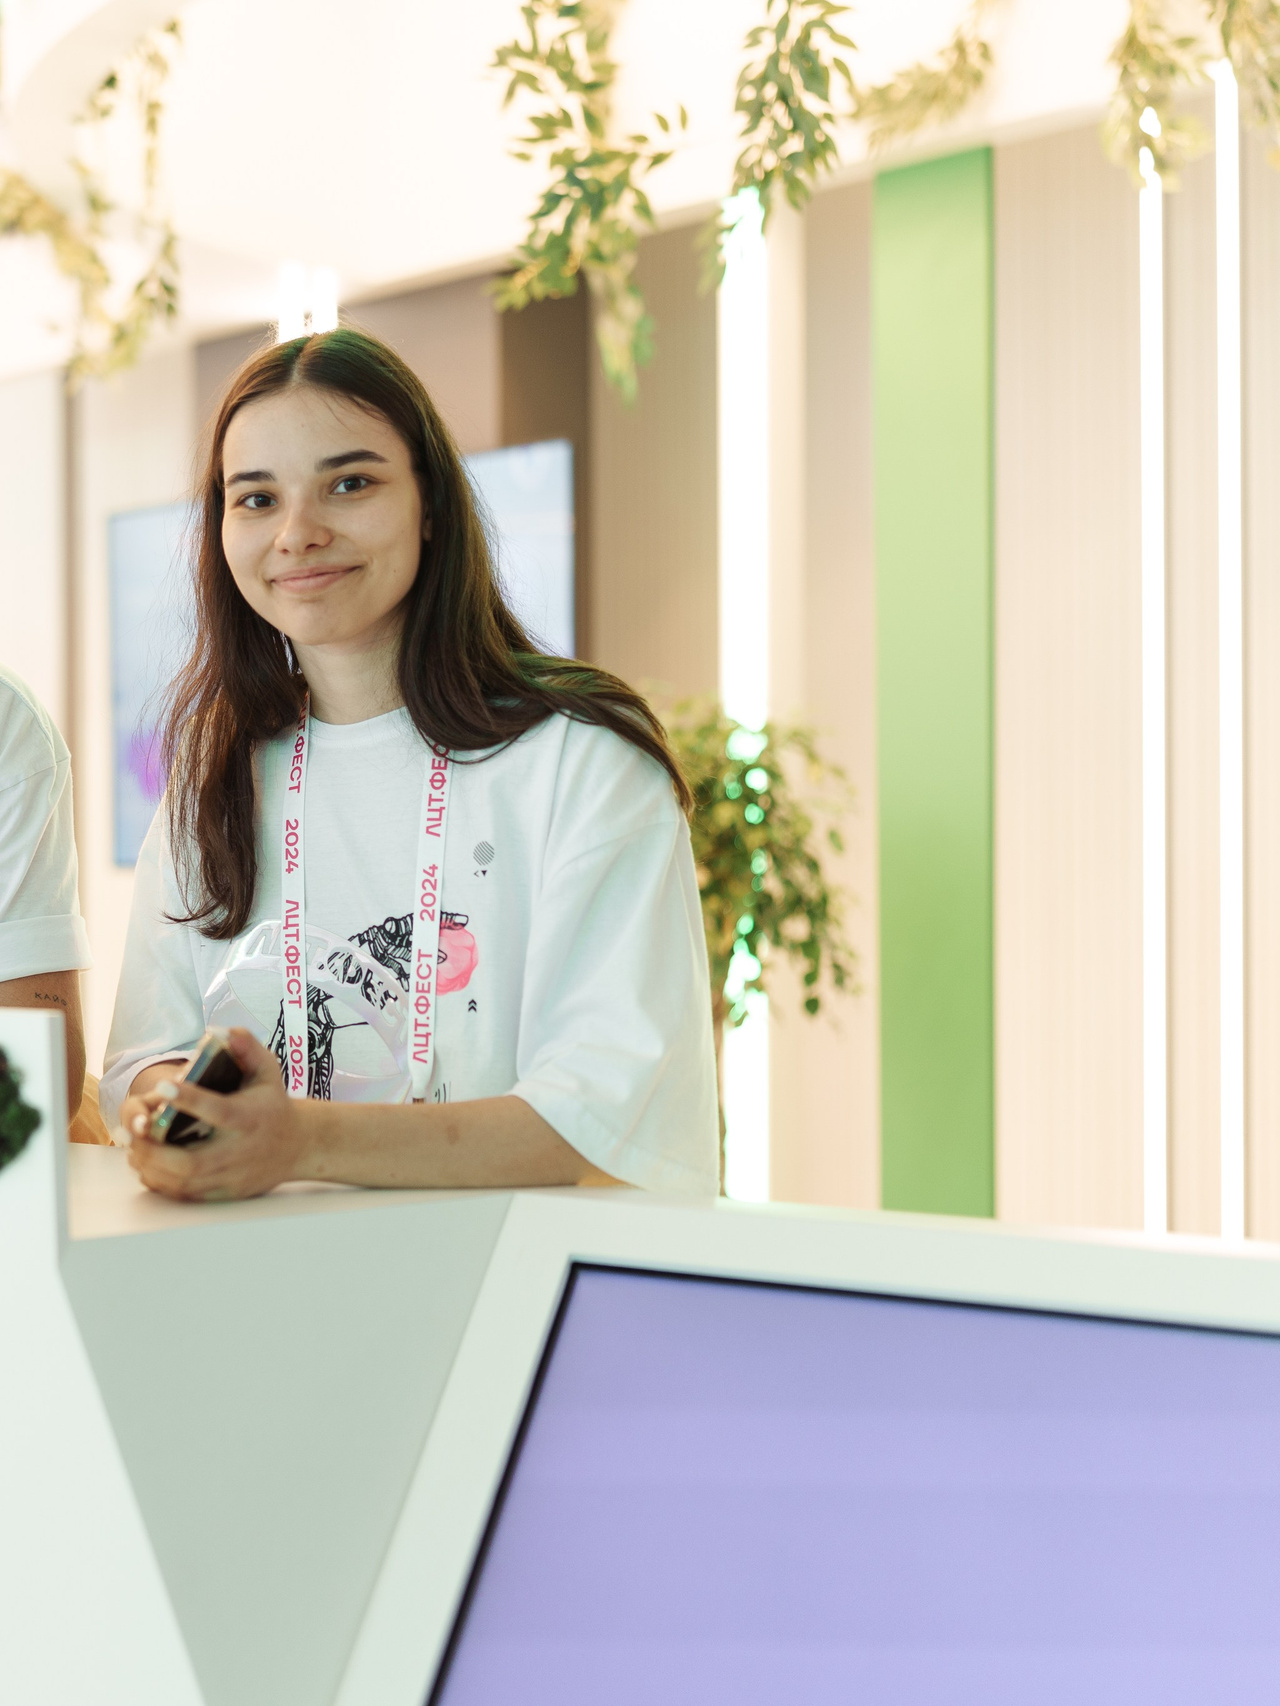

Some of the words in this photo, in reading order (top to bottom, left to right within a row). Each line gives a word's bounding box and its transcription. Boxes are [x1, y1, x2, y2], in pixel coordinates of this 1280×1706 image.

[425, 742, 451, 838] ЛЦТ.ФЕС
[285, 818, 300, 874] 2024
[419, 863, 438, 922] 2024
[288, 1034, 305, 1092] 2024
